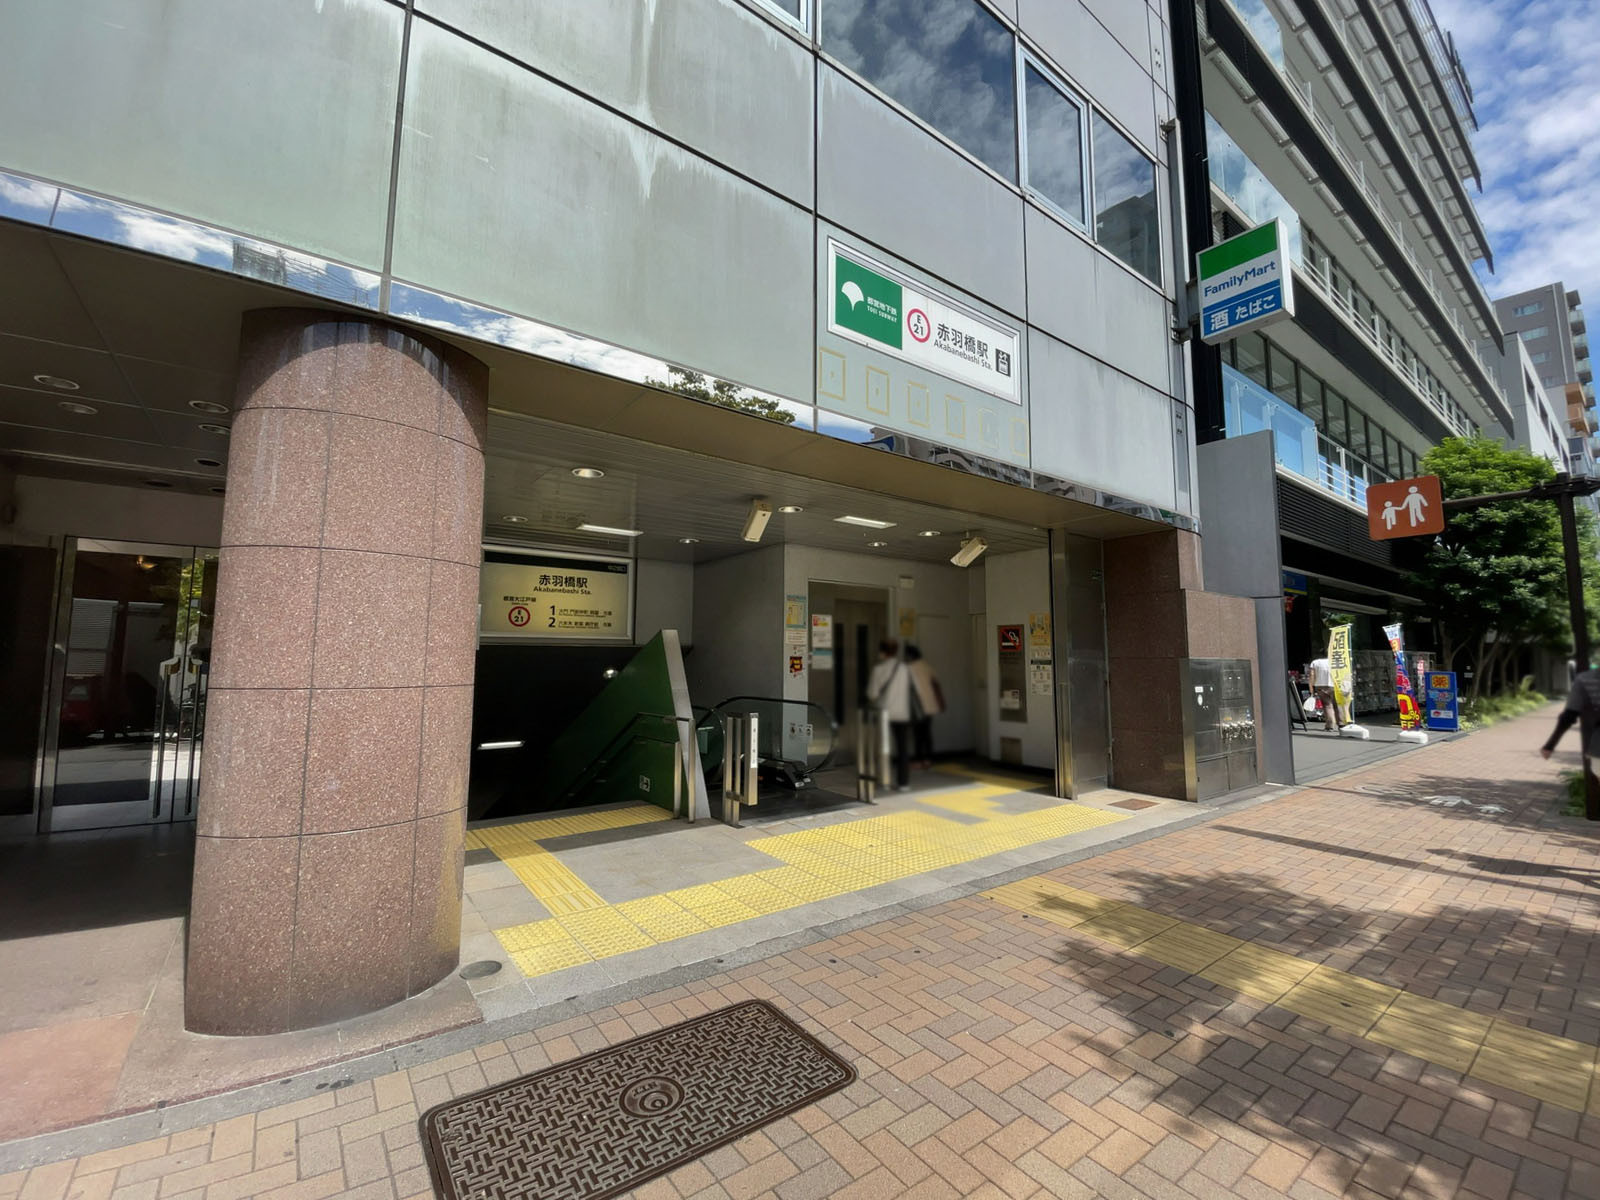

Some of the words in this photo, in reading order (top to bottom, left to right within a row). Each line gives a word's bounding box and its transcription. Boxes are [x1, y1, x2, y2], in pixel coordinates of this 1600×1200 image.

[1204, 261, 1276, 297] FamilyMart
[916, 314, 921, 324] E
[1210, 309, 1229, 331] 酒
[1236, 295, 1276, 320] たばこ
[913, 323, 924, 336] 21
[937, 323, 989, 360] 赤羽橋駅
[933, 340, 980, 365] Akabanebashi
[981, 359, 993, 370] Sta.
[539, 574, 588, 588] 赤羽橋駅
[533, 585, 579, 594] Akabanebashi
[549, 605, 556, 616] 1
[548, 617, 556, 628] 2
